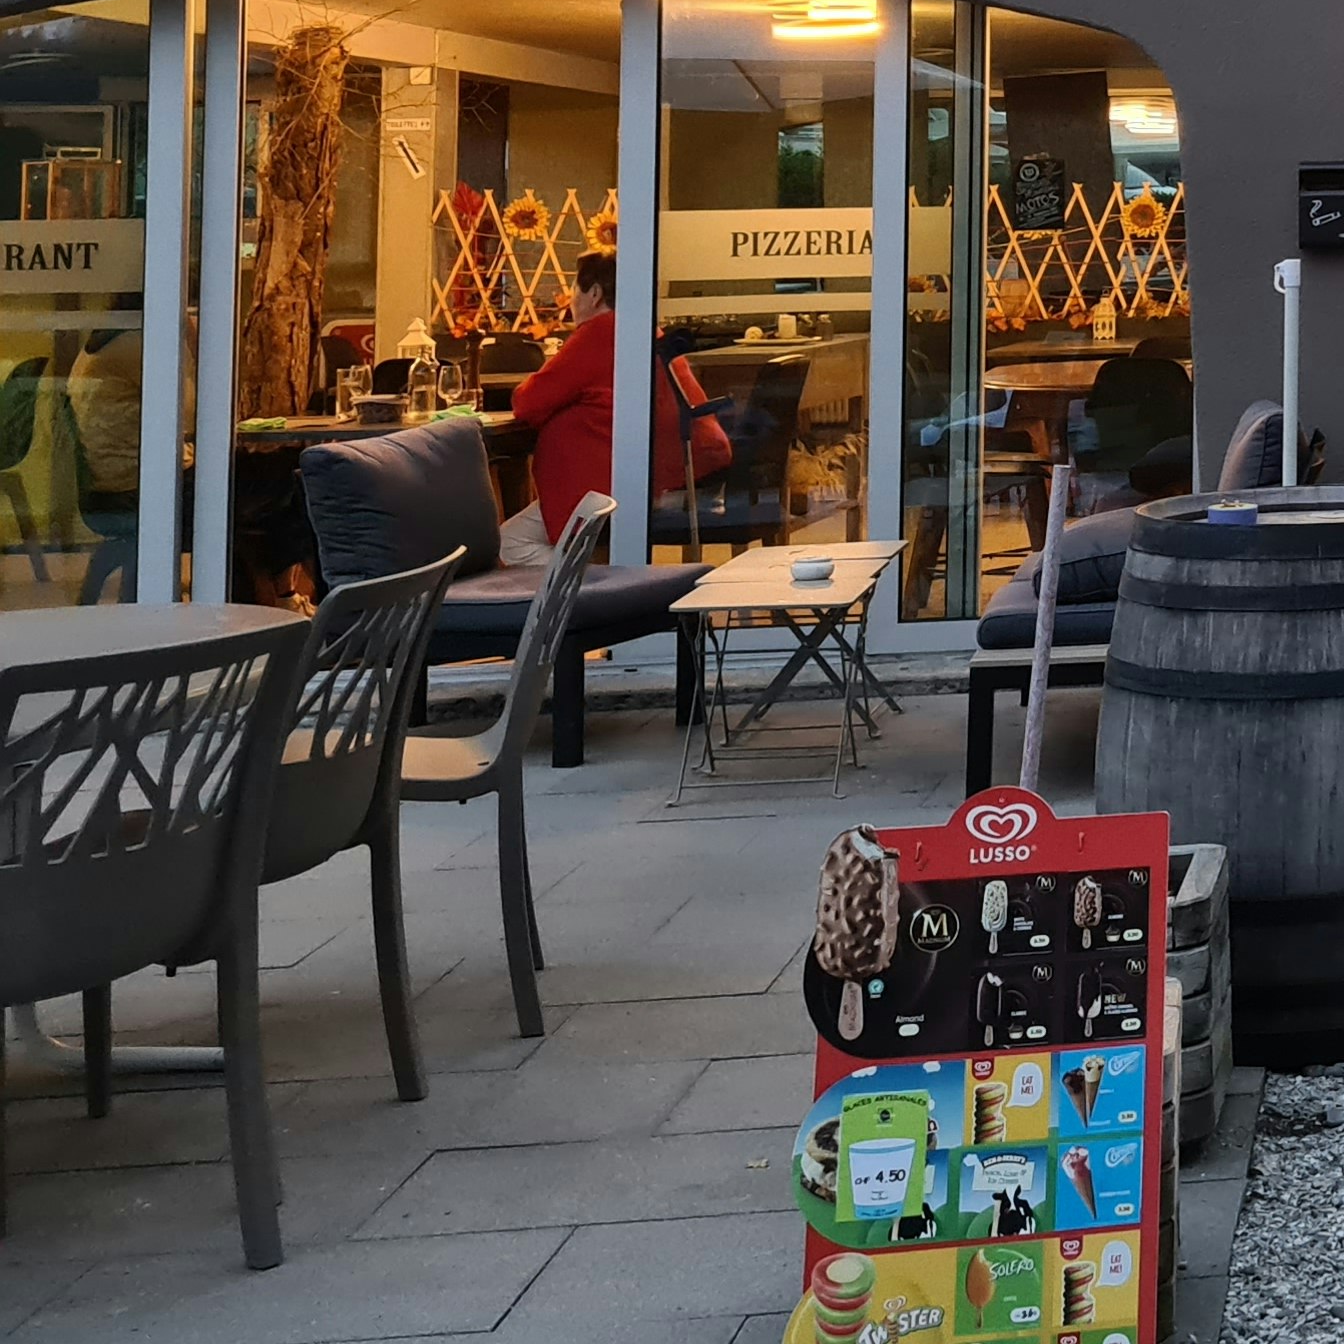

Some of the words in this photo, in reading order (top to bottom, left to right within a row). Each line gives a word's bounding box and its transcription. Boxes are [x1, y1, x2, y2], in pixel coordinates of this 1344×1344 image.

[730, 229, 873, 257] PIZZERIA
[969, 845, 1030, 864] LUSSO
[921, 912, 949, 938] M
[895, 1014, 925, 1024] Almond
[1021, 1076, 1033, 1086] EAT
[875, 1169, 906, 1184] 4.50
[1110, 1254, 1122, 1264] EAT
[989, 1258, 1035, 1280] SOLERO
